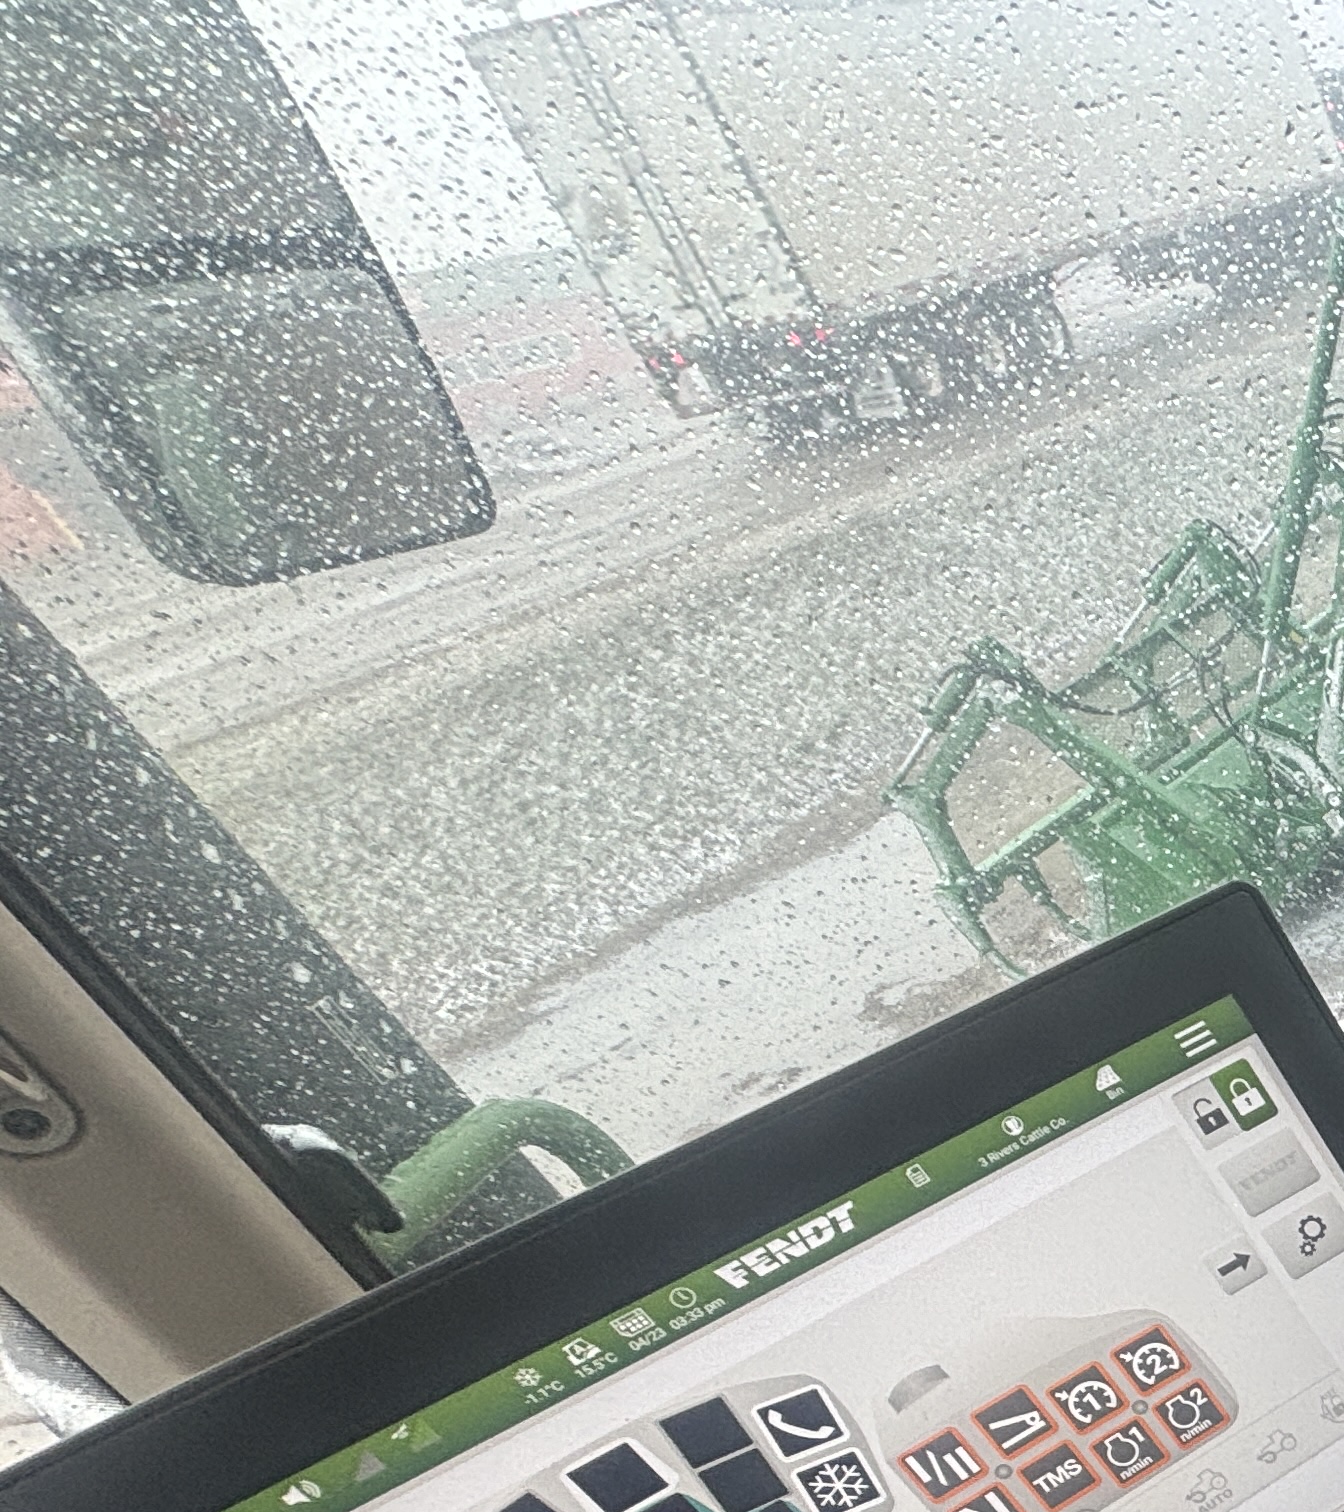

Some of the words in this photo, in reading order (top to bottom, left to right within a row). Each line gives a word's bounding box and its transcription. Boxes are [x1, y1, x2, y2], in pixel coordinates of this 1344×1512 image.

[1106, 1086, 1125, 1100] Bin
[978, 1156, 988, 1167] 3
[989, 1142, 1020, 1163] Rivers
[1020, 1124, 1050, 1146] Cattle
[1050, 1116, 1070, 1130] Co.
[713, 1200, 855, 1289] FENDT
[669, 1306, 705, 1331] 03:33
[705, 1298, 726, 1315] pm
[629, 1327, 667, 1351] 04/23
[574, 1352, 619, 1378] 15.5°C
[1146, 1353, 1167, 1375] 2
[525, 1380, 565, 1404] -1.1°C
[1082, 1391, 1102, 1411] 1
[1189, 1388, 1208, 1405] 2
[1127, 1426, 1146, 1443] 1
[1179, 1418, 1212, 1442] n/min
[1033, 1458, 1083, 1494] TMS
[1120, 1454, 1154, 1480] n/min
